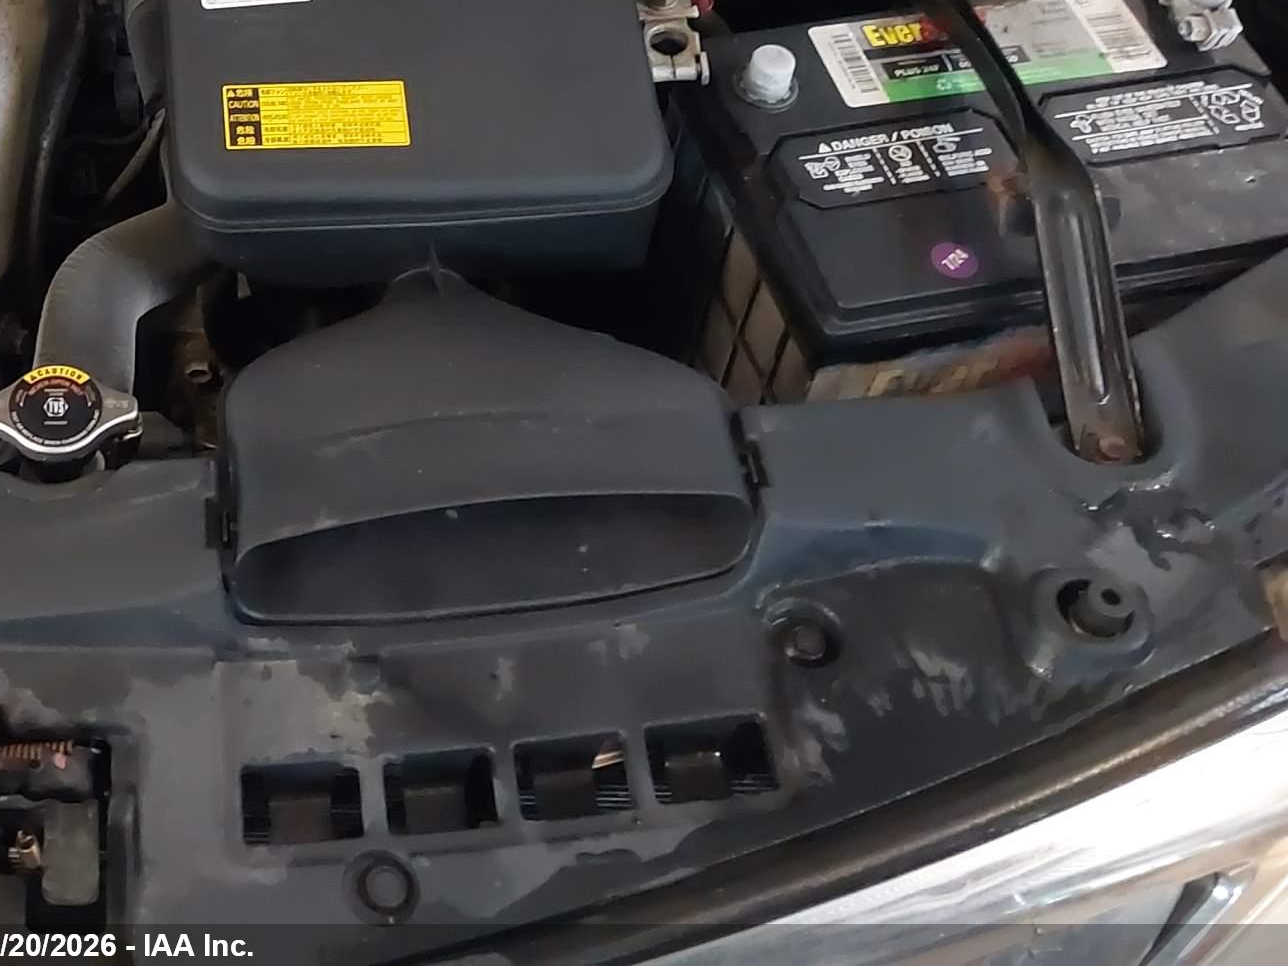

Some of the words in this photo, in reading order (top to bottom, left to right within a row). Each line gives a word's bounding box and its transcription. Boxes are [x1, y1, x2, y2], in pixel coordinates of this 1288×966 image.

[862, 21, 926, 48] Ever
[228, 100, 259, 109] CAUTION
[831, 131, 889, 152] DANGER
[900, 121, 953, 140] POISON
[37, 367, 83, 381] CAUTION
